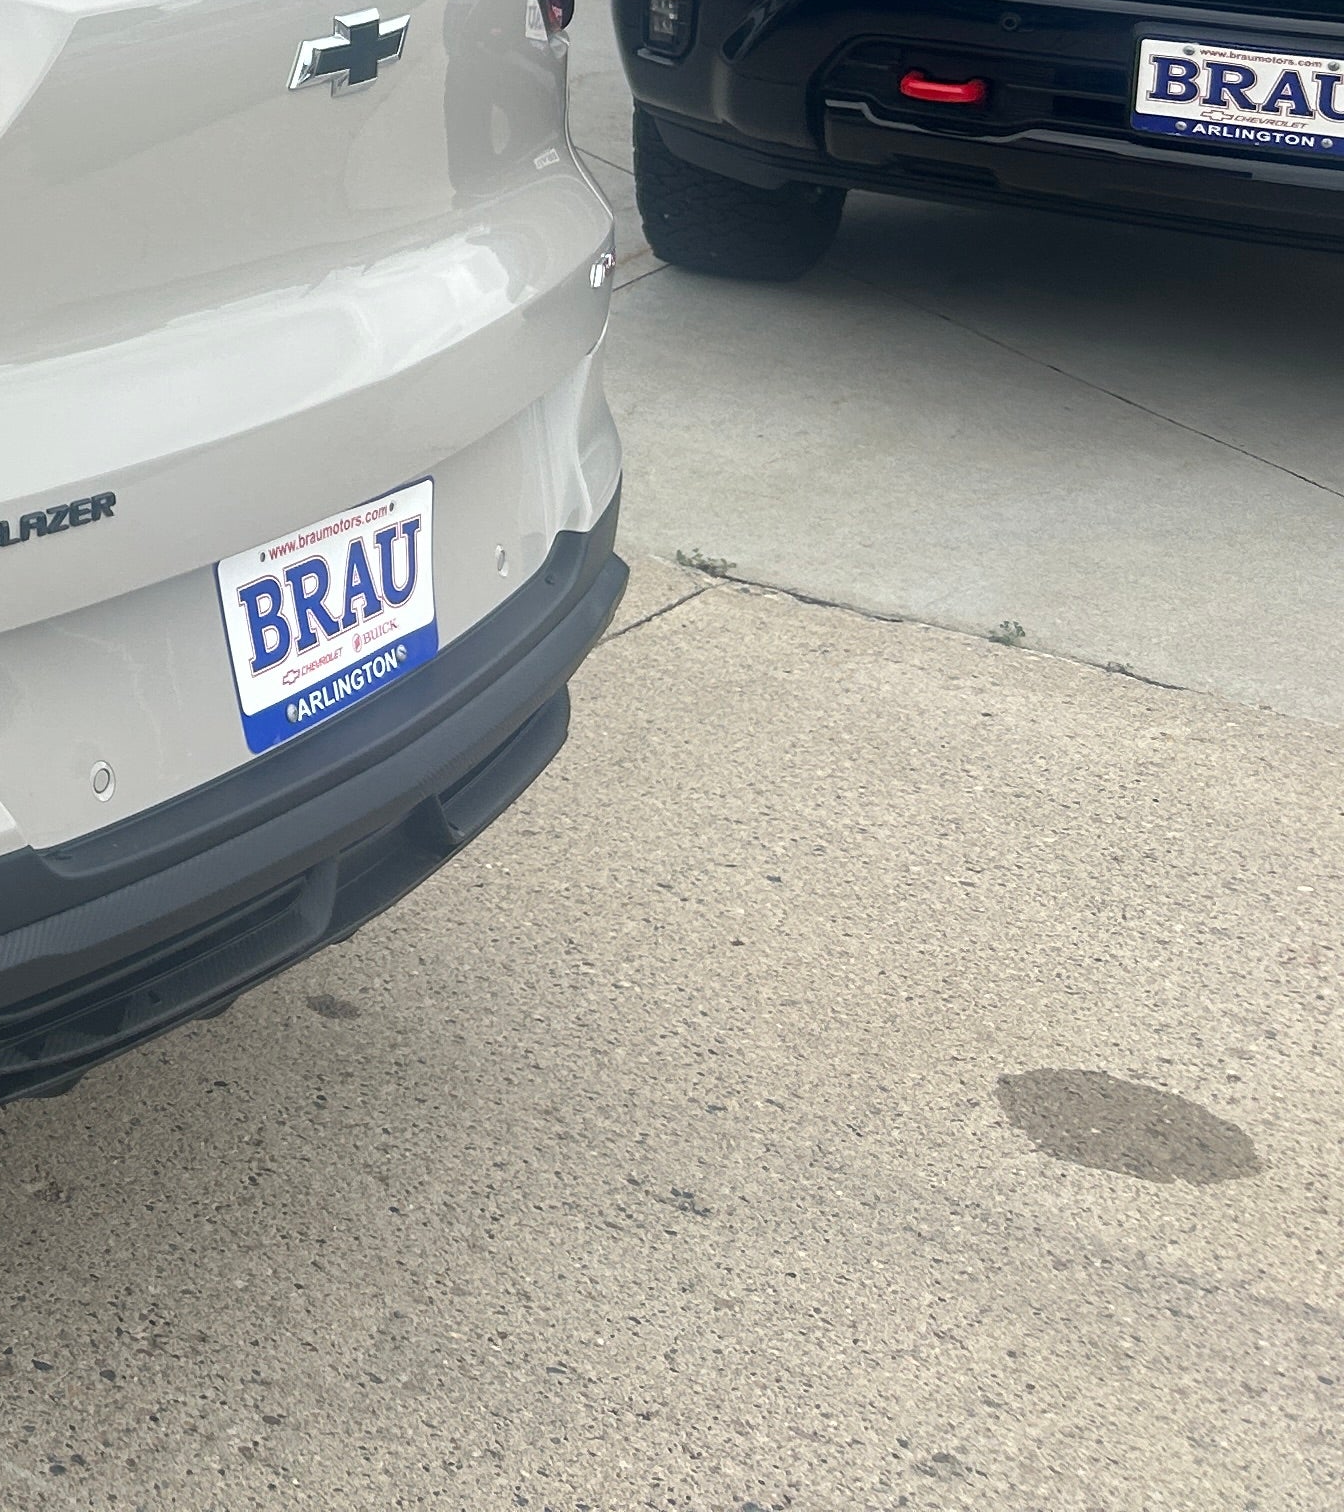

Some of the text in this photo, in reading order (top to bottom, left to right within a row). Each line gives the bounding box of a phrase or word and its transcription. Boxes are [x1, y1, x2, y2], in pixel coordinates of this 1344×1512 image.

[1199, 48, 1323, 68] www.braumotors.com
[1192, 123, 1315, 148] ARLINGTON
[1234, 115, 1309, 129] CHEVROLET
[268, 504, 388, 561] www.braumotors.com
[236, 514, 421, 678] BRAU
[301, 619, 398, 676] CHEVROLET BUICK
[297, 652, 398, 722] ARLINGTON
